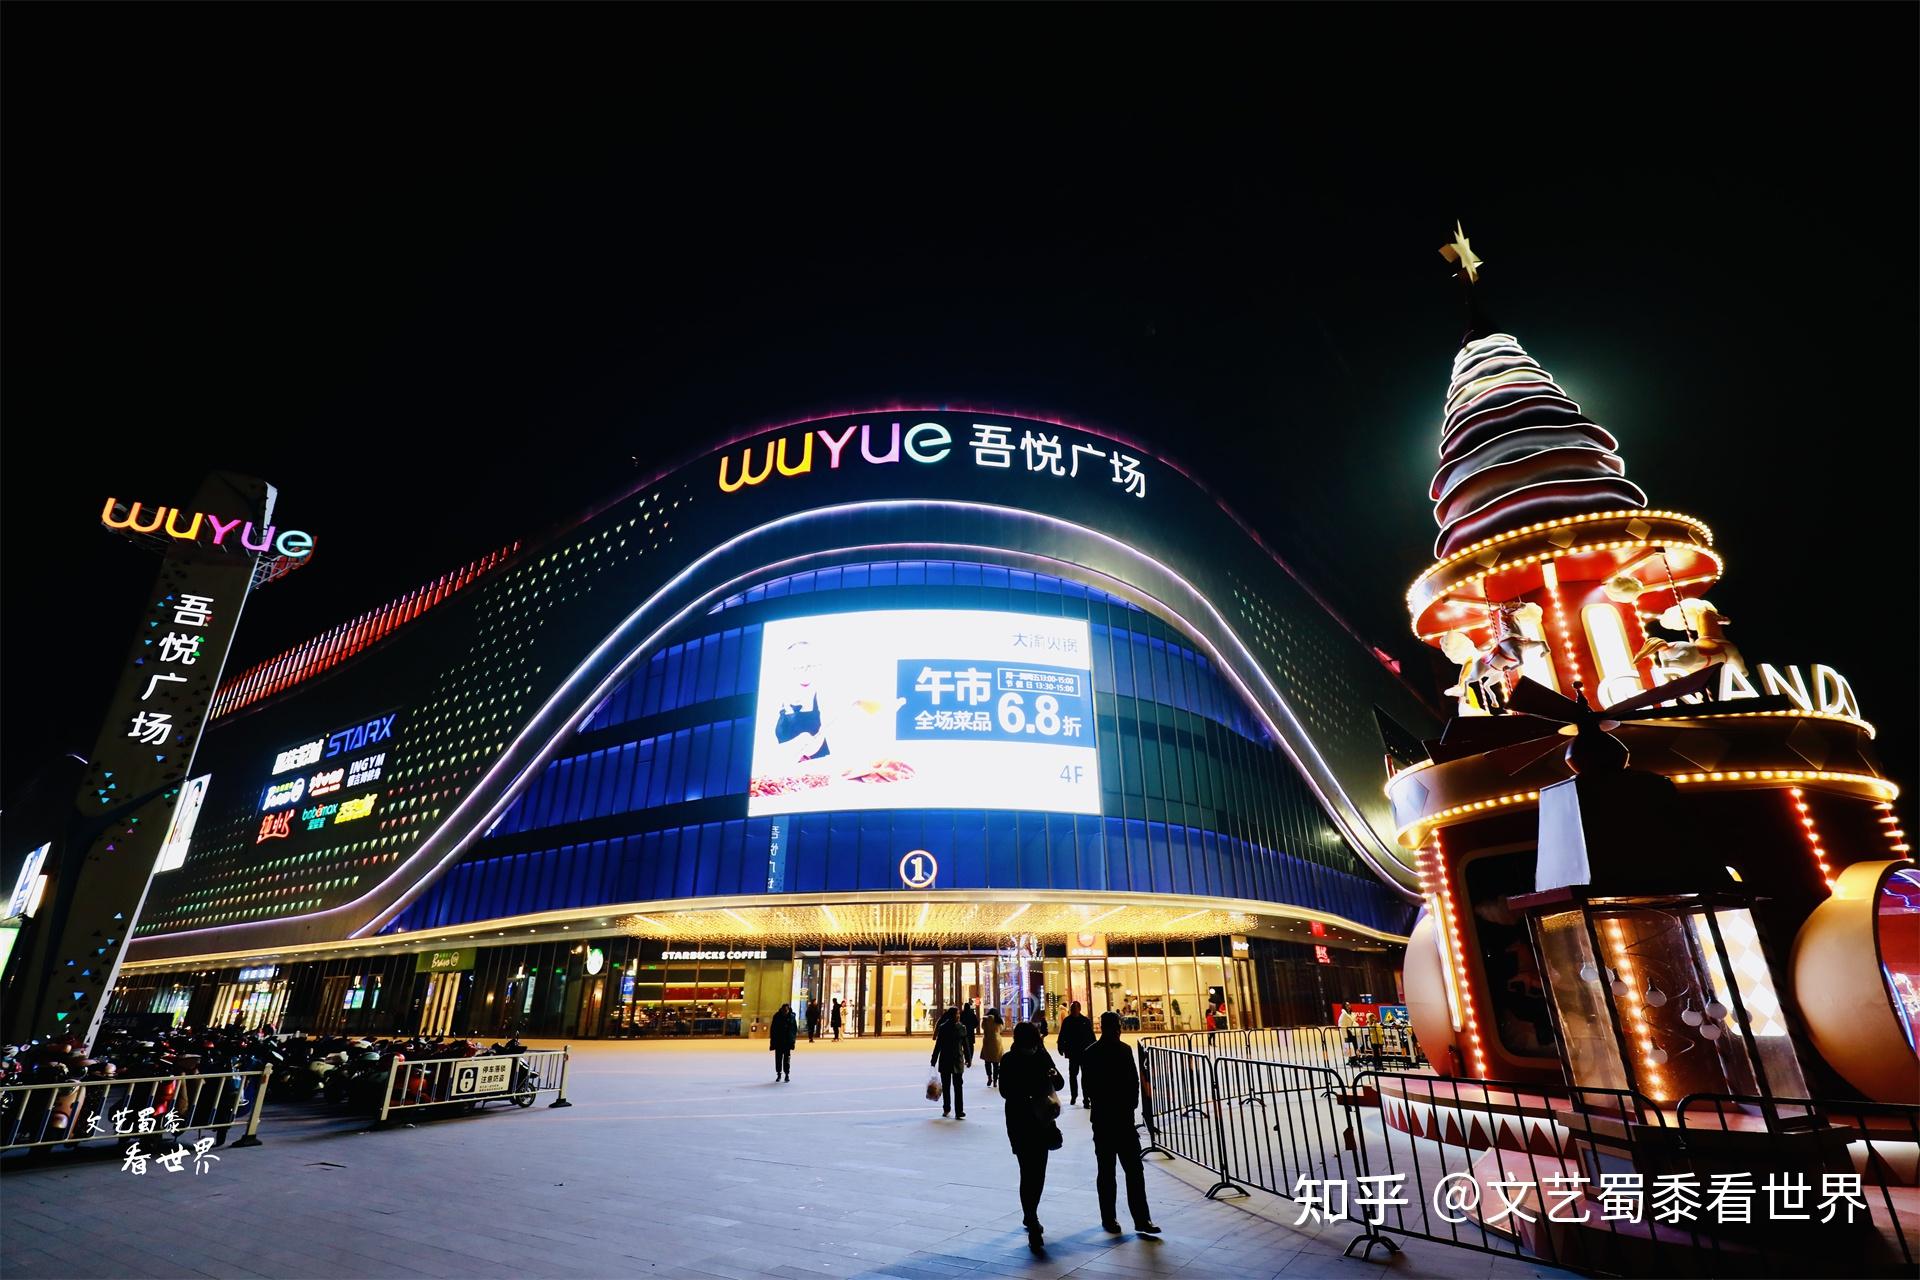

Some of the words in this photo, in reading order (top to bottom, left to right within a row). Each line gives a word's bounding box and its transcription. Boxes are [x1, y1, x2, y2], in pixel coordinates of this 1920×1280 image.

[968, 423, 1146, 499] 吾悦广场
[128, 593, 214, 745] 吾悦广场
[915, 666, 992, 706] 午市
[326, 713, 396, 758] STARX
[914, 710, 992, 732] 全场菜品
[350, 752, 386, 775] INGYM
[1060, 765, 1083, 784] 4F
[661, 951, 726, 960] STARBUCKS
[726, 950, 768, 960] COFFEE
